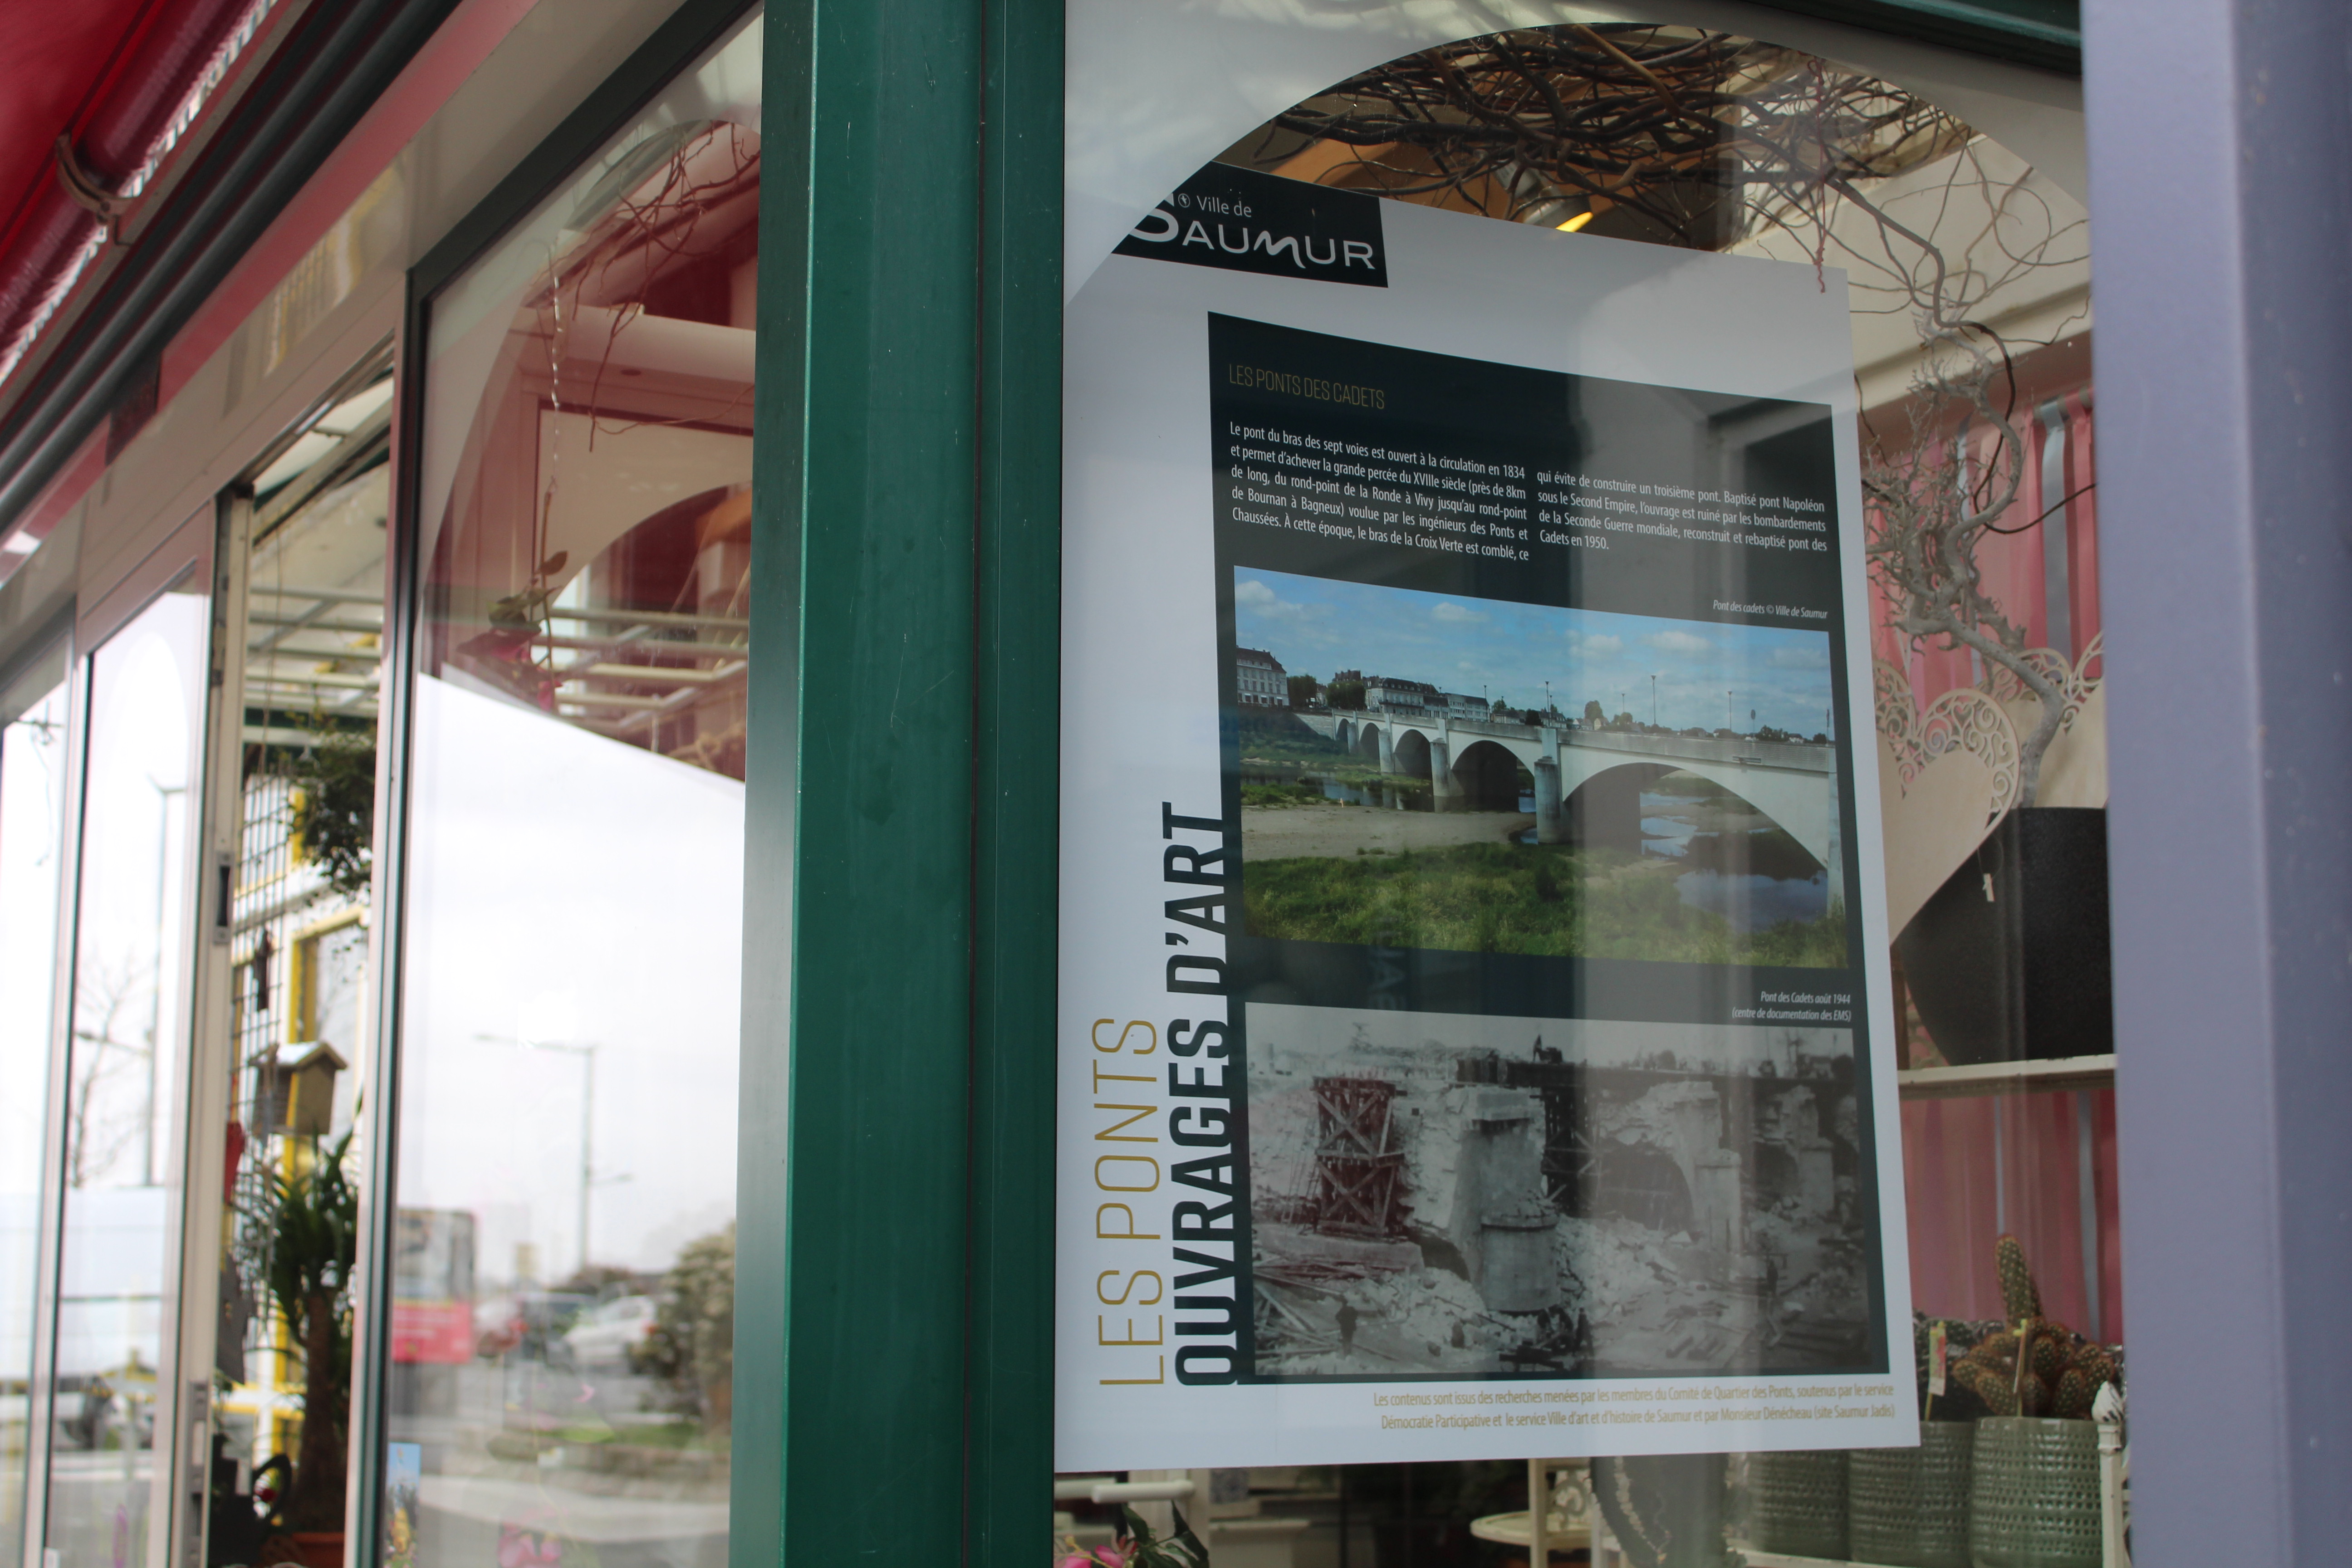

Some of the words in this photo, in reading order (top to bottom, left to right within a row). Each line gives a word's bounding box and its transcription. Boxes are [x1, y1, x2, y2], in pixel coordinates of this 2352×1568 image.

[1197, 196, 1229, 214] Ville
[1234, 201, 1251, 217] de
[1230, 364, 1252, 387] LES
[1257, 369, 1300, 395] PONTS
[1304, 377, 1329, 401] DES
[1333, 382, 1384, 409] CADETS
[1230, 421, 1240, 436] Le
[1244, 427, 1264, 440] pont
[1268, 428, 1279, 442] du
[1283, 430, 1302, 446] bras
[1305, 434, 1320, 449] des
[1324, 441, 1343, 455] sept
[1346, 443, 1368, 456] voies
[1372, 448, 1385, 459] est
[1388, 451, 1417, 464] ouvert
[1420, 452, 1425, 465] à
[1429, 453, 1436, 466] la
[1440, 456, 1485, 473] circulation
[1489, 466, 1499, 475] en
[1503, 465, 1524, 479] 1834
[1231, 445, 1240, 456] et
[1243, 448, 1275, 463] permet
[1278, 451, 1320, 470] d’achever
[1323, 458, 1331, 472] la
[1334, 463, 1365, 477] grande
[1368, 468, 1397, 482] percée
[1400, 470, 1411, 484] du
[1414, 472, 1439, 487] XVIIIe
[1442, 477, 1465, 491] siècle
[1469, 480, 1490, 496] (près
[1493, 483, 1504, 496] de
[1506, 485, 1525, 499] 8km
[1232, 464, 1242, 478] de
[1248, 466, 1269, 485] long,
[1275, 471, 1286, 485] du
[1291, 476, 1339, 494] rond-point
[1344, 482, 1355, 496] de
[1360, 484, 1367, 498] la
[1373, 486, 1401, 503] Ronde
[1406, 491, 1411, 504] à
[1415, 492, 1433, 510] Vivy
[1438, 496, 1475, 514] jusqu’au
[1480, 503, 1527, 520] rond-point
[1232, 485, 1243, 500] de
[1248, 488, 1286, 506] Bournan
[1291, 495, 1296, 508] à
[1302, 496, 1343, 517] Bagneux)
[1349, 506, 1379, 520] voulue
[1384, 512, 1398, 524] par
[1403, 511, 1415, 525] les
[1420, 514, 1466, 532] ingénieurs
[1470, 520, 1485, 534] des
[1490, 523, 1514, 539] Ponts
[1519, 529, 1528, 540] et
[1537, 470, 1551, 485] qui
[1554, 471, 1576, 485] évite
[1579, 474, 1590, 487] de
[1593, 479, 1636, 493] construire
[1640, 485, 1651, 494] un
[1654, 485, 1695, 499] troisième
[1698, 491, 1720, 503] pont.
[1725, 491, 1756, 507] Baptisé
[1759, 497, 1780, 509] pont
[1783, 496, 1824, 513] Napoléon
[1538, 492, 1558, 503] sous
[1560, 491, 1568, 505] le
[1571, 493, 1602, 509] Second
[1605, 497, 1637, 514] Empire,
[1641, 501, 1679, 519] l’ouvrage
[1682, 508, 1695, 519] est
[1698, 509, 1720, 521] ruiné
[1723, 513, 1737, 525] par
[1740, 511, 1751, 524] les
[1754, 513, 1826, 532] bombardements
[1233, 507, 1281, 527] Chaussées.
[1284, 512, 1290, 529] À
[1294, 519, 1316, 532] cette
[1319, 520, 1355, 539] époque,
[1358, 525, 1366, 539] le
[1369, 527, 1387, 542] bras
[1391, 530, 1401, 544] de
[1405, 532, 1412, 546] la
[1416, 534, 1437, 549] Croix
[1439, 537, 1463, 552] Verte
[1466, 543, 1479, 554] est
[1482, 544, 1516, 560] comblé,
[1519, 550, 1529, 560] ce
[1539, 509, 1550, 523] de
[1553, 510, 1561, 524] la
[1564, 512, 1601, 529] Seconde
[1604, 517, 1633, 532] Guerre
[1637, 523, 1680, 539] mondiale,
[1684, 529, 1730, 542] reconstruit
[1734, 533, 1742, 543] et
[1745, 533, 1785, 549] rebaptisé
[1788, 539, 1809, 551] pont
[1812, 538, 1827, 551] des
[1540, 529, 1569, 545] Cadets
[1571, 536, 1582, 546] en
[1585, 535, 1608, 549] 1950.
[1713, 600, 1729, 611] Pont
[1730, 601, 1741, 612] des
[1743, 603, 1764, 614] cadets
[1776, 605, 1790, 616] Ville
[1791, 606, 1799, 617] de
[1801, 607, 1828, 619] Saumur
[1162, 801, 1227, 996] D’ART
[1761, 991, 1777, 1002] Pont
[1778, 992, 1790, 1003] des
[1791, 992, 1813, 1003] Cadets
[1815, 994, 1831, 1004] août
[1834, 994, 1850, 1004] 1944
[1092, 1018, 1161, 1240] PONTS
[1166, 1019, 1238, 1387] OUVRAGES
[1096, 1269, 1164, 1386] LES
[1374, 1392, 1389, 1406] Les
[1391, 1393, 1431, 1406] contenus
[1433, 1392, 1453, 1405] sont
[1455, 1392, 1476, 1405] issus
[1478, 1391, 1494, 1404] des
[1495, 1390, 1543, 1404] recherches
[1544, 1389, 1579, 1403] menées
[1581, 1392, 1596, 1405] par
[1597, 1388, 1610, 1401] les
[1612, 1388, 1653, 1401] membres
[1655, 1388, 1666, 1401] du
[1669, 1387, 1699, 1400] Comité
[1714, 1386, 1749, 1400] Quartier
[1752, 1386, 1767, 1399] des
[1769, 1385, 1795, 1399] Ponts,
[1797, 1386, 1837, 1397] soutenus
[1838, 1387, 1852, 1399] par
[1864, 1385, 1894, 1396] service
[1382, 1415, 1434, 1429] Démocratie
[1436, 1414, 1491, 1431] Participative
[1515, 1412, 1546, 1426] service
[1548, 1411, 1567, 1425] Ville
[1657, 1409, 1691, 1422] Saumur
[1705, 1411, 1719, 1424] par
[1721, 1408, 1762, 1421] Monsieur
[1834, 1405, 1868, 1418] Saumur
